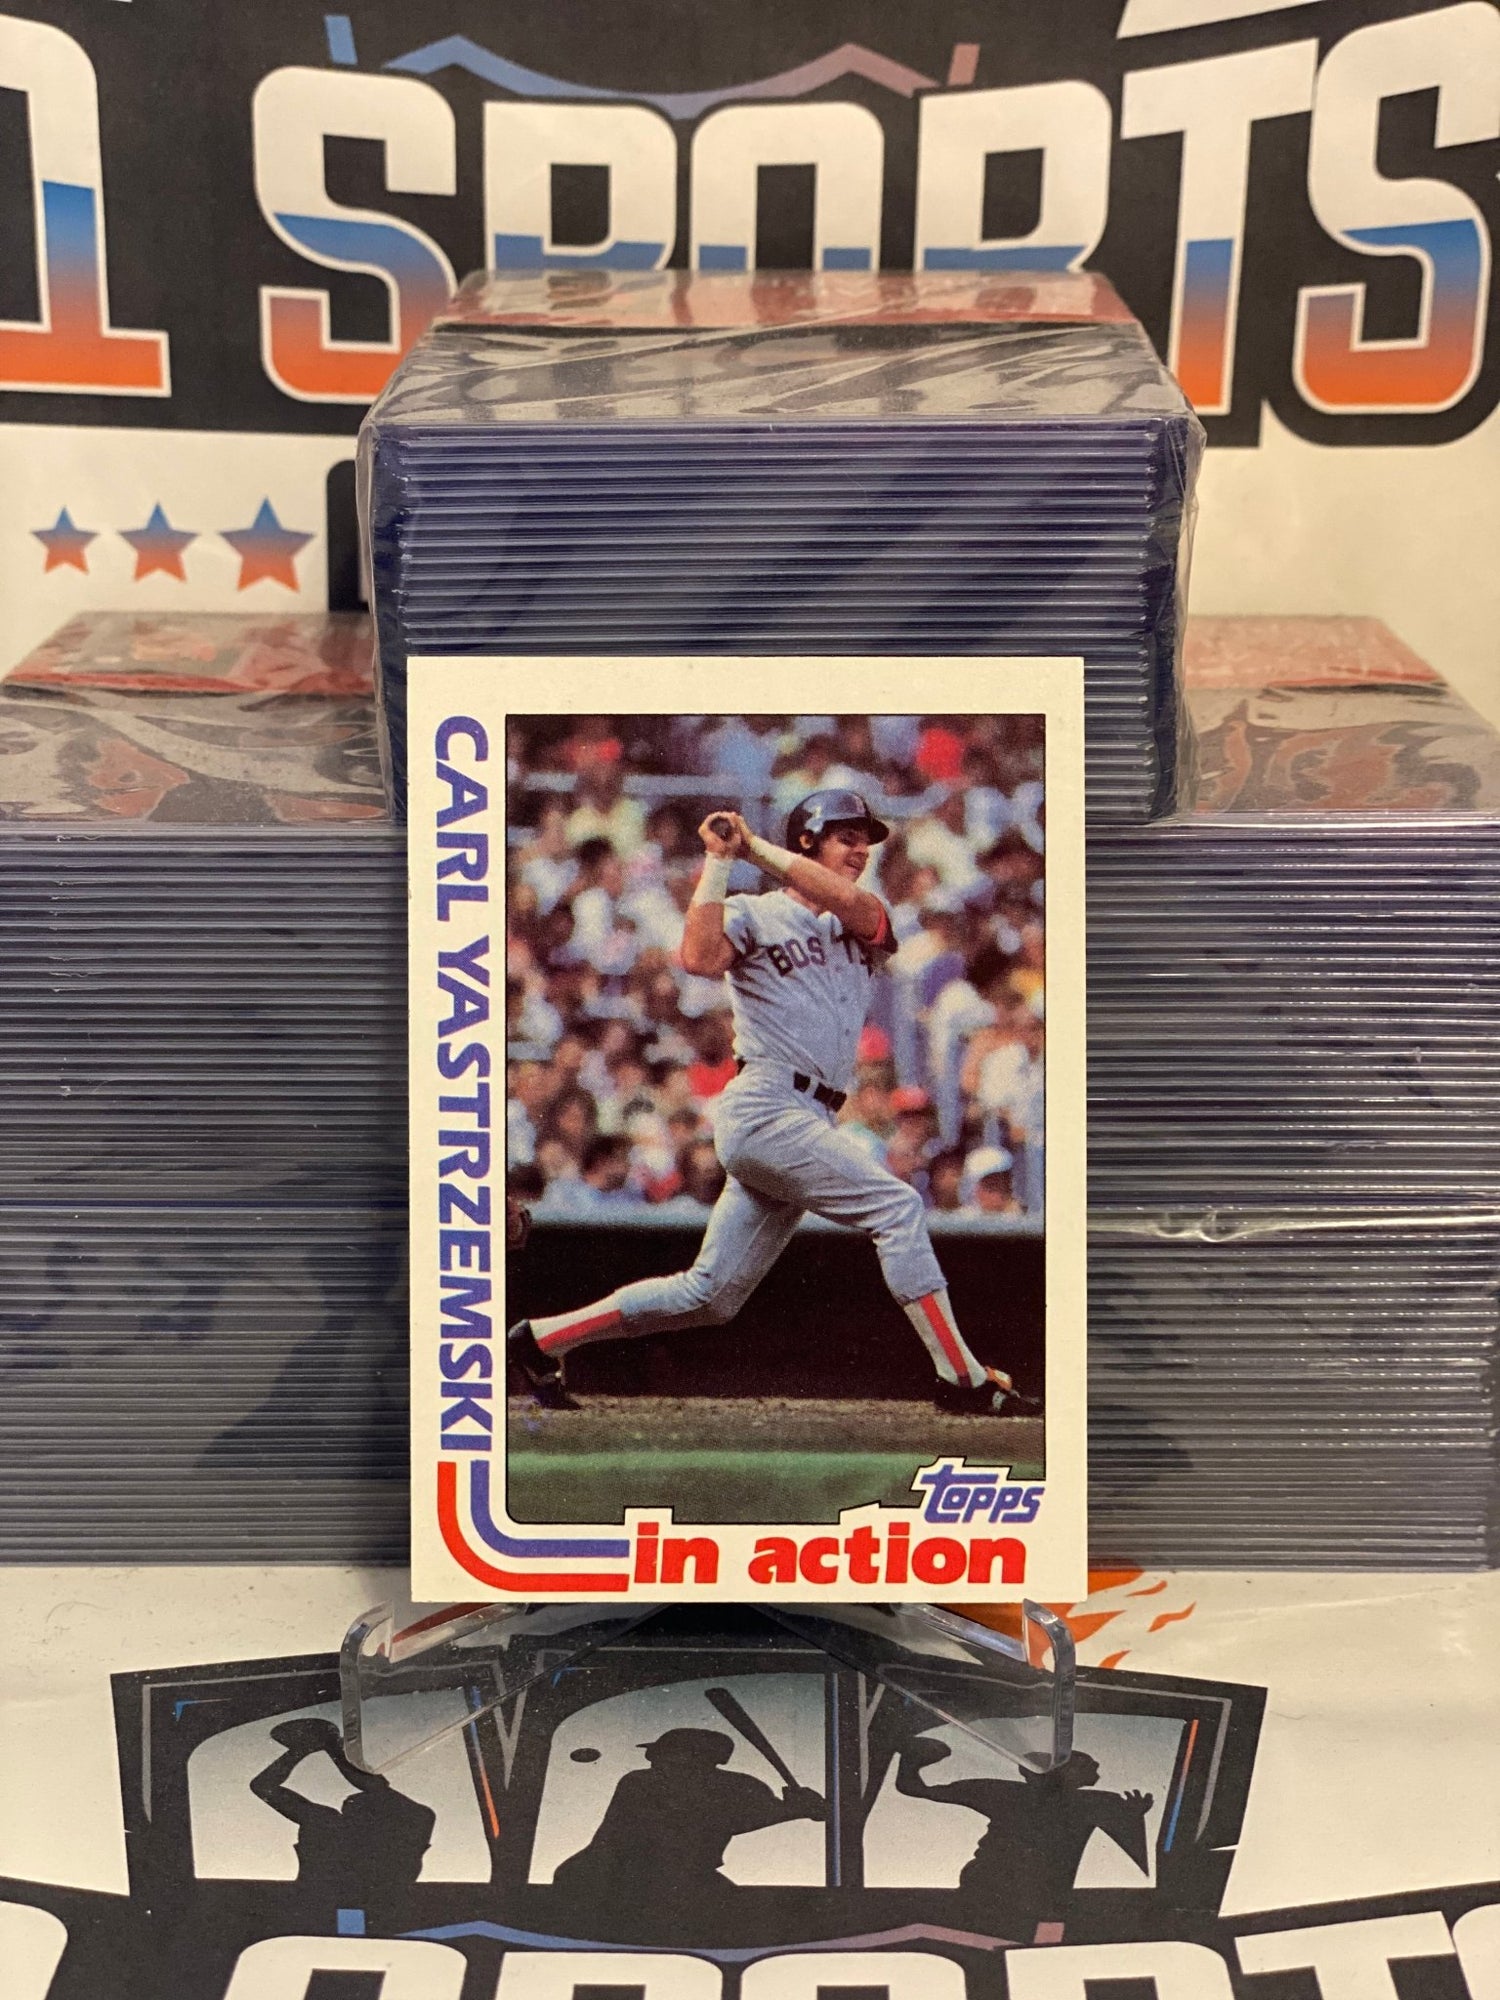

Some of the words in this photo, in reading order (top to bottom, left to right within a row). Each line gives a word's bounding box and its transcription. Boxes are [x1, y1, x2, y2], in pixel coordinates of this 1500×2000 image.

[434, 715, 489, 922] CARL
[436, 934, 494, 1451] YASTRZEMSKI
[634, 1521, 720, 1584] in
[747, 1521, 1027, 1585] action
